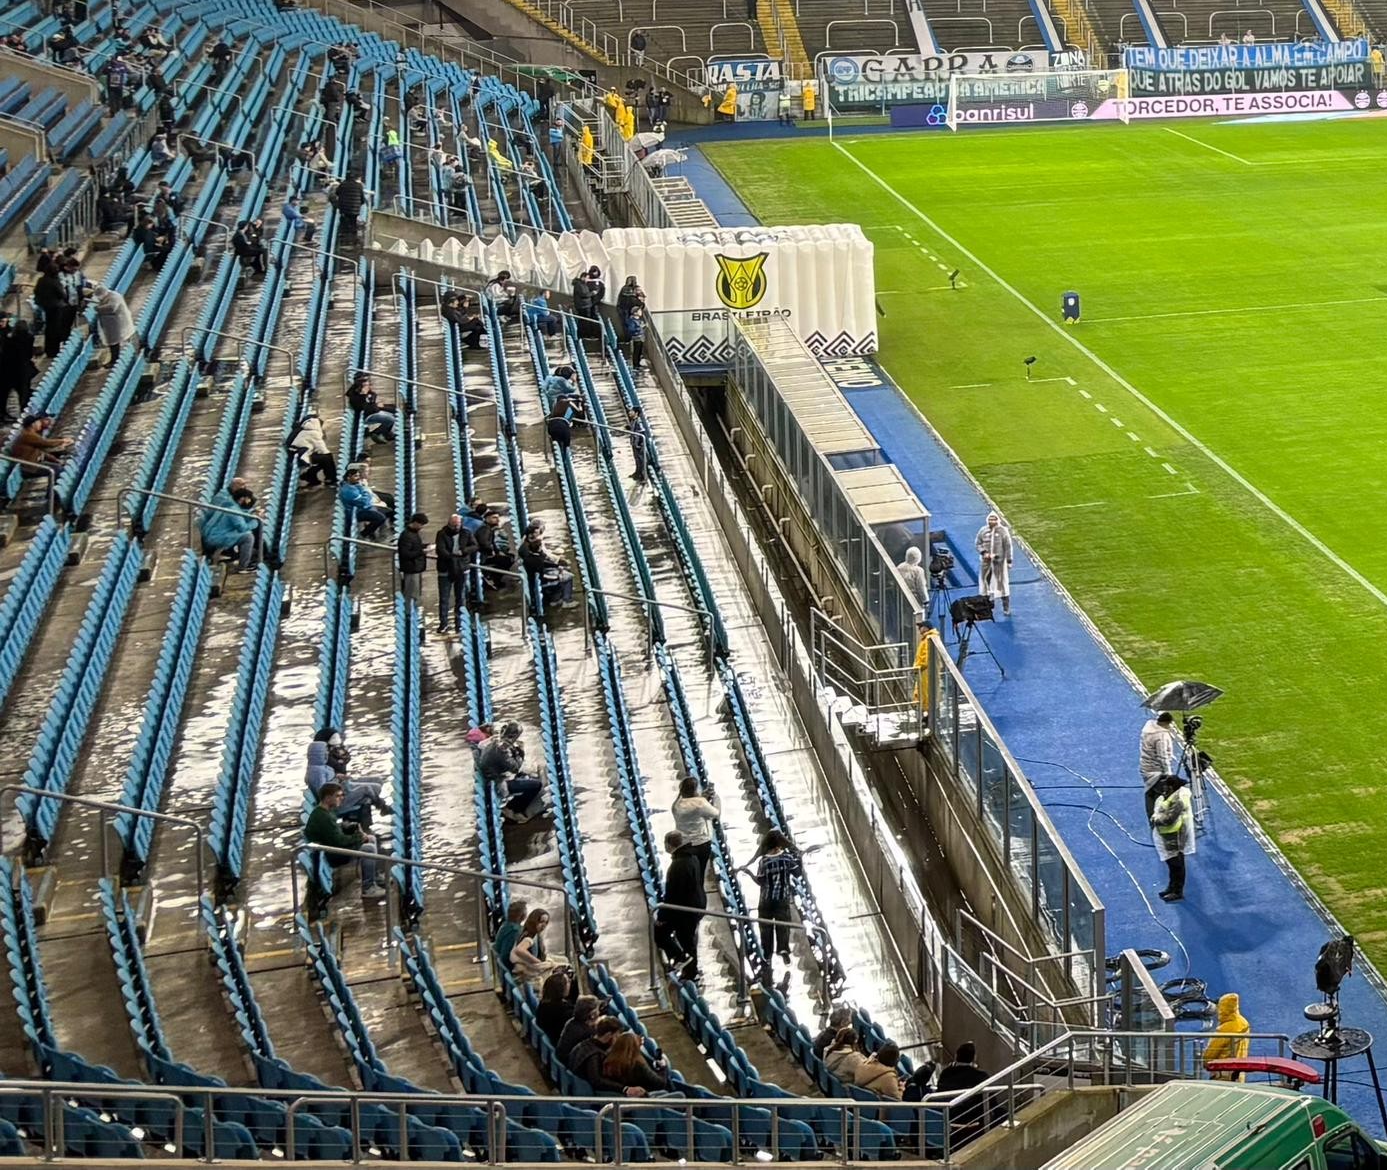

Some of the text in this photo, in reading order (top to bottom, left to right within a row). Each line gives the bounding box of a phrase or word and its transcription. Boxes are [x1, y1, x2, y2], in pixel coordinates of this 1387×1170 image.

[1052, 51, 1085, 67] ZONA
[1158, 47, 1188, 68] QUE
[1189, 45, 1238, 67] DEIXAR
[1240, 45, 1250, 66] A
[1252, 43, 1290, 65] ALMA
[1158, 69, 1201, 92] ATRAS
[1203, 68, 1222, 90] DO
[1224, 67, 1250, 89] GOL
[1253, 65, 1296, 89] VAMOS
[1299, 64, 1316, 87] TE
[1223, 95, 1245, 110] TE
[1249, 93, 1333, 110] ASSOCIA!
